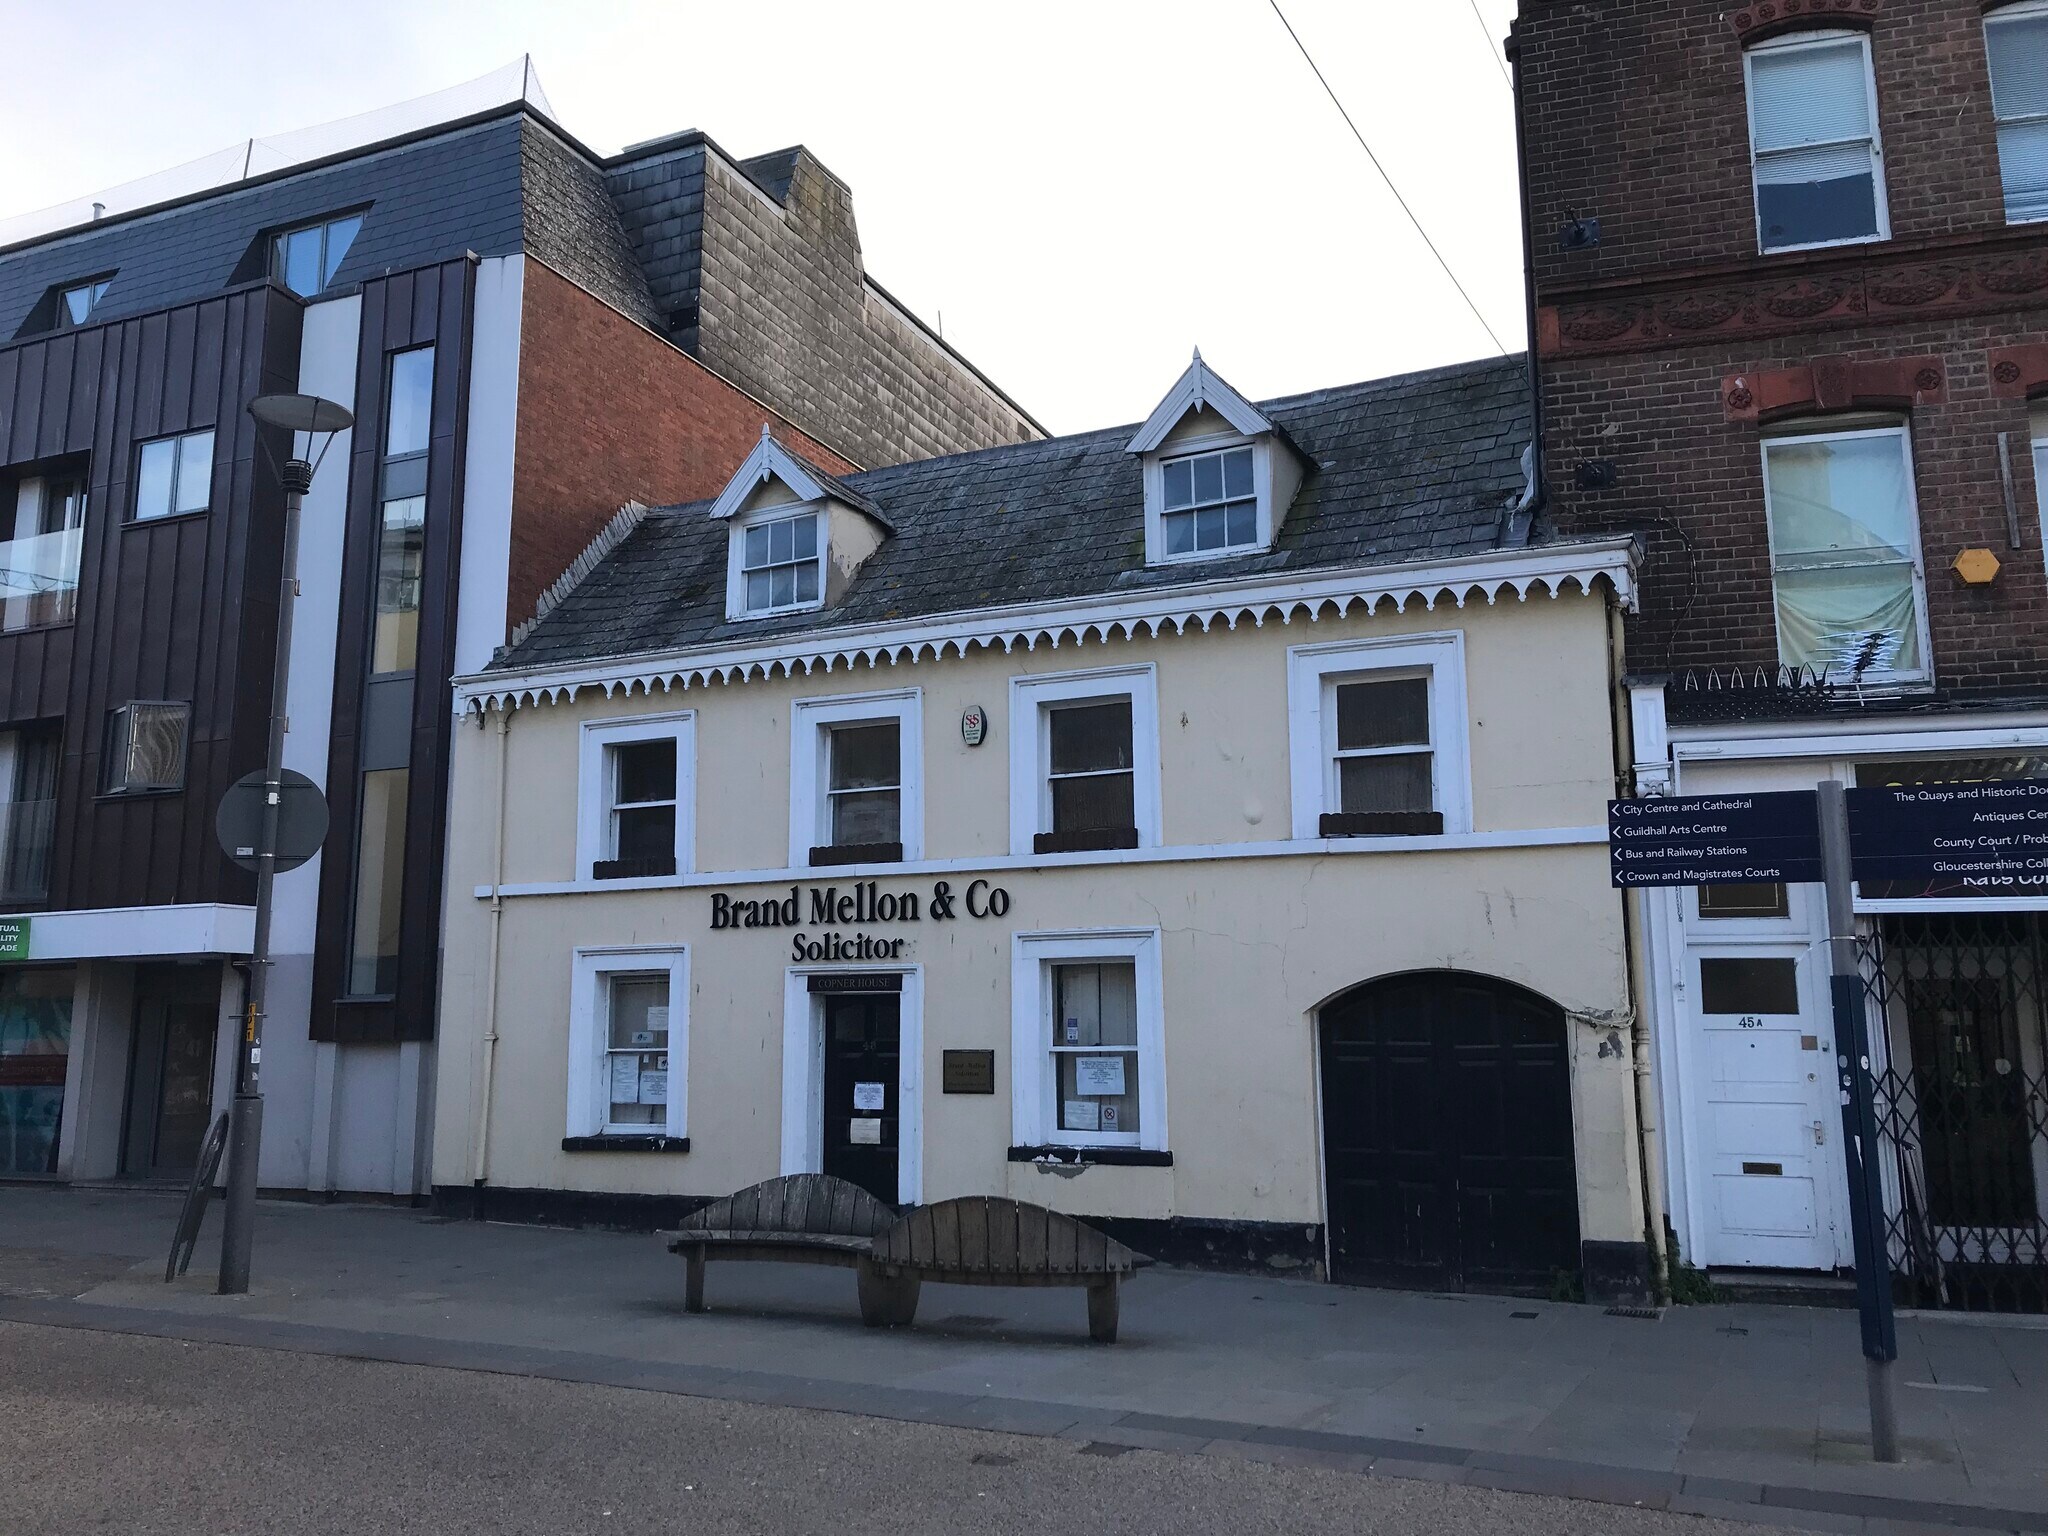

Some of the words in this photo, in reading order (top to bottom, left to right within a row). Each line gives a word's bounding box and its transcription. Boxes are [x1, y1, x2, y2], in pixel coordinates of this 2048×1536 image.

[1893, 791, 1916, 802] The
[1918, 790, 1954, 802] Quays
[1957, 787, 1979, 799] and
[1981, 786, 2027, 798] Historic
[2028, 785, 2048, 796] Do
[1623, 805, 1643, 816] City
[1645, 803, 1679, 814] Centre
[1681, 801, 1700, 812] and
[1702, 798, 1752, 811] Cathedral
[1973, 811, 2025, 823] Antiques
[1624, 825, 1667, 837] Guildhall
[1669, 825, 1691, 835] Arts
[1692, 823, 1728, 834] Centre
[1933, 837, 1975, 849] County
[1978, 835, 2012, 846] Court
[1625, 849, 1644, 859] Bus
[1645, 847, 1665, 858] and
[1667, 846, 1705, 858] Railway
[1706, 845, 1748, 856] Stations
[1933, 859, 2024, 872] Gloucestershire
[1626, 871, 1660, 881] Crown
[1661, 869, 1681, 880] and
[1683, 868, 1743, 881] Magistrates
[1744, 867, 1780, 878] Courts
[709, 884, 800, 929] Brand
[809, 881, 920, 925] Mellon
[929, 880, 956, 921] &
[965, 878, 1010, 919] Co
[792, 932, 904, 962] Solicitor
[857, 977, 890, 988] HOUSE
